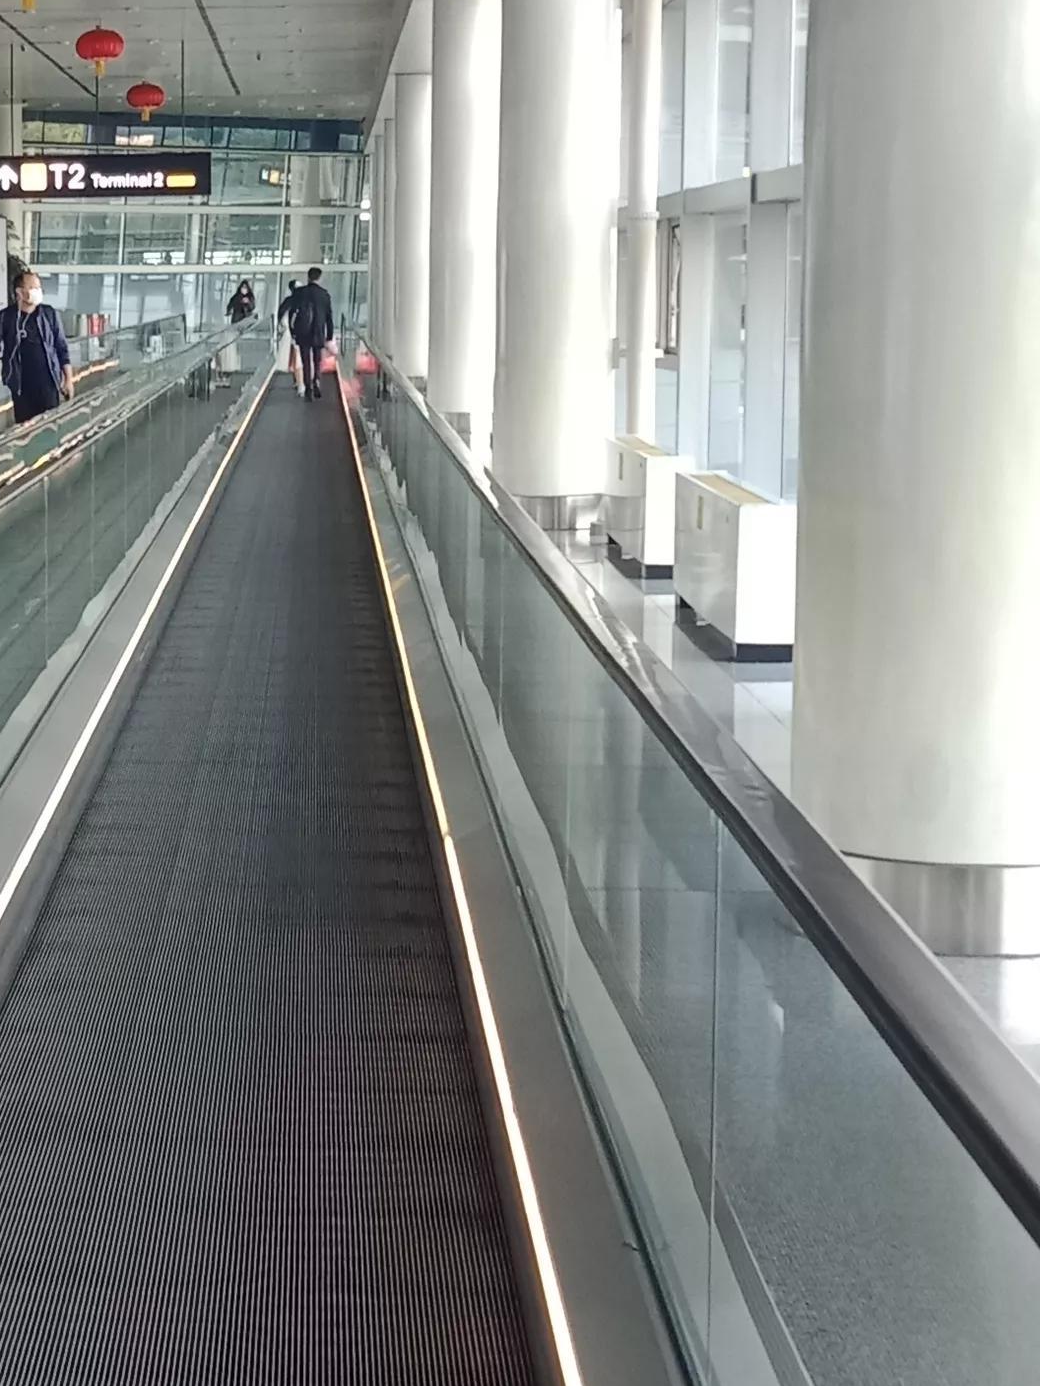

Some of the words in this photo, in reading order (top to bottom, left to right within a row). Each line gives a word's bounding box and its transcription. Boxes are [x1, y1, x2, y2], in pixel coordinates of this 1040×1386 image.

[48, 163, 86, 190] T2
[90, 172, 152, 189] Terminal
[153, 172, 165, 188] 2
